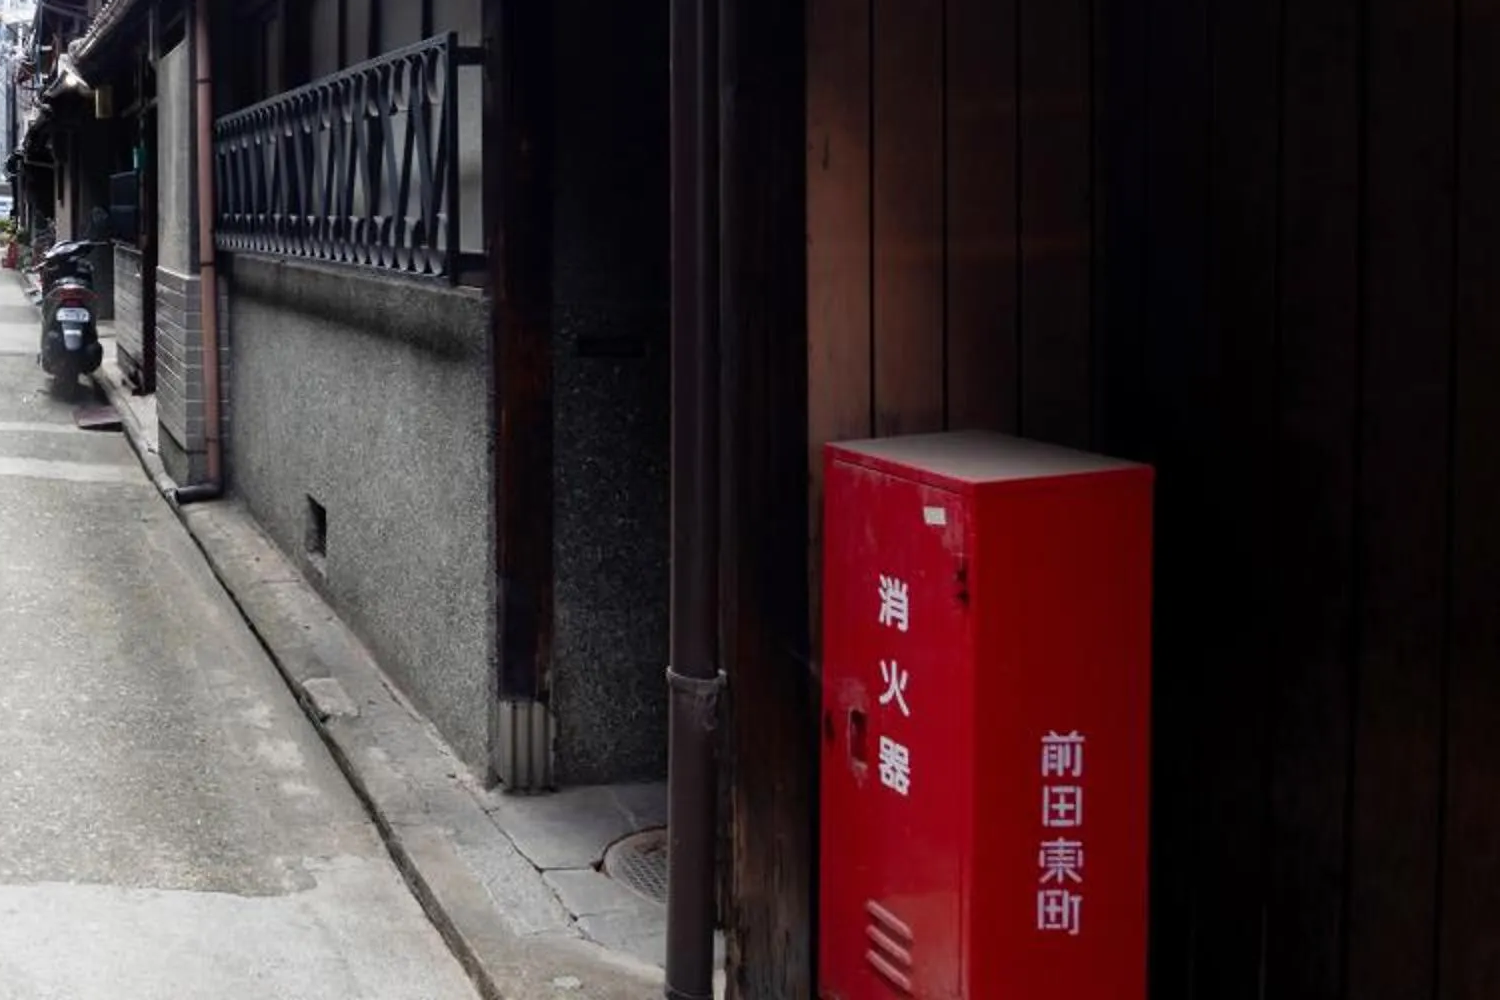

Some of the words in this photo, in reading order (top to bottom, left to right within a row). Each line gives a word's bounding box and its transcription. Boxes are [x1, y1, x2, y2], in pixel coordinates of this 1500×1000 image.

[878, 574, 910, 796] 消火器
[1037, 730, 1084, 935] 前田東町
